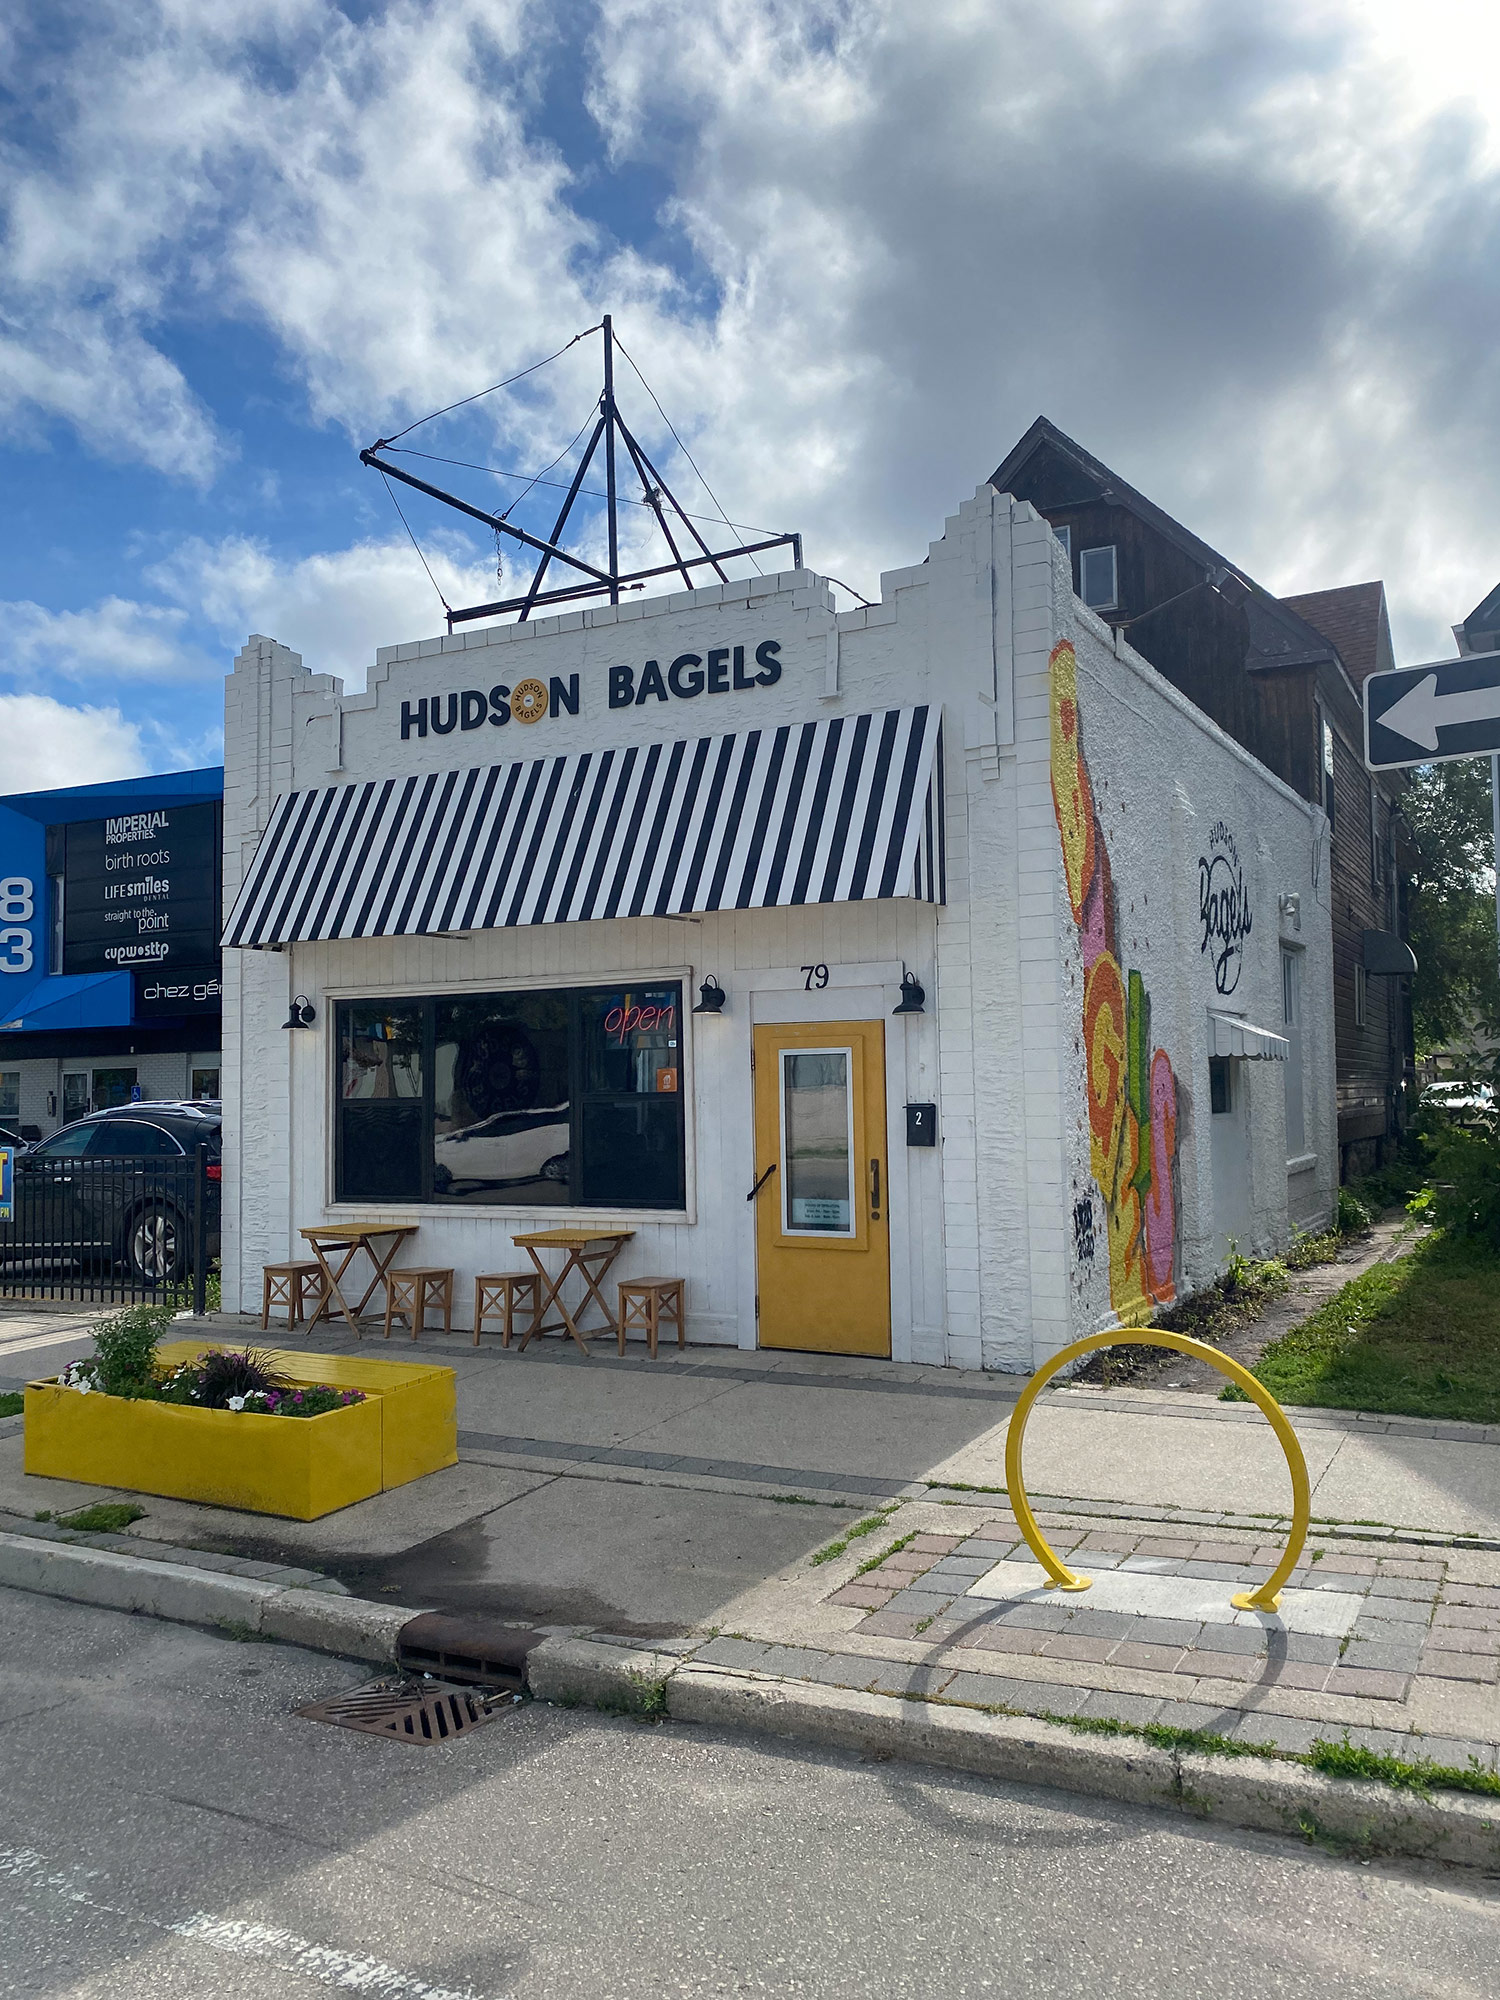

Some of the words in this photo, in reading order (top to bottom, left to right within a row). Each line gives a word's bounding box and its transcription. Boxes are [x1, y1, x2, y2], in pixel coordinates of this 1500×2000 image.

[400, 672, 580, 741] HUDSON
[608, 639, 783, 710] BAGELS
[514, 682, 544, 702] HUDSON
[514, 702, 543, 719] BAGELS
[106, 811, 169, 835] IMPERIAL
[1209, 821, 1240, 868] HUDSON
[105, 852, 134, 871] birth
[136, 849, 170, 867] roots
[143, 893, 170, 902] DENTAL
[104, 909, 132, 923] straight
[133, 910, 142, 919] to
[142, 907, 155, 918] the
[138, 913, 170, 934] point
[1198, 857, 1253, 996] Bagels
[800, 963, 829, 991] 79
[144, 982, 190, 1000] chez
[604, 1005, 674, 1045] open
[915, 1111, 922, 1126] 2
